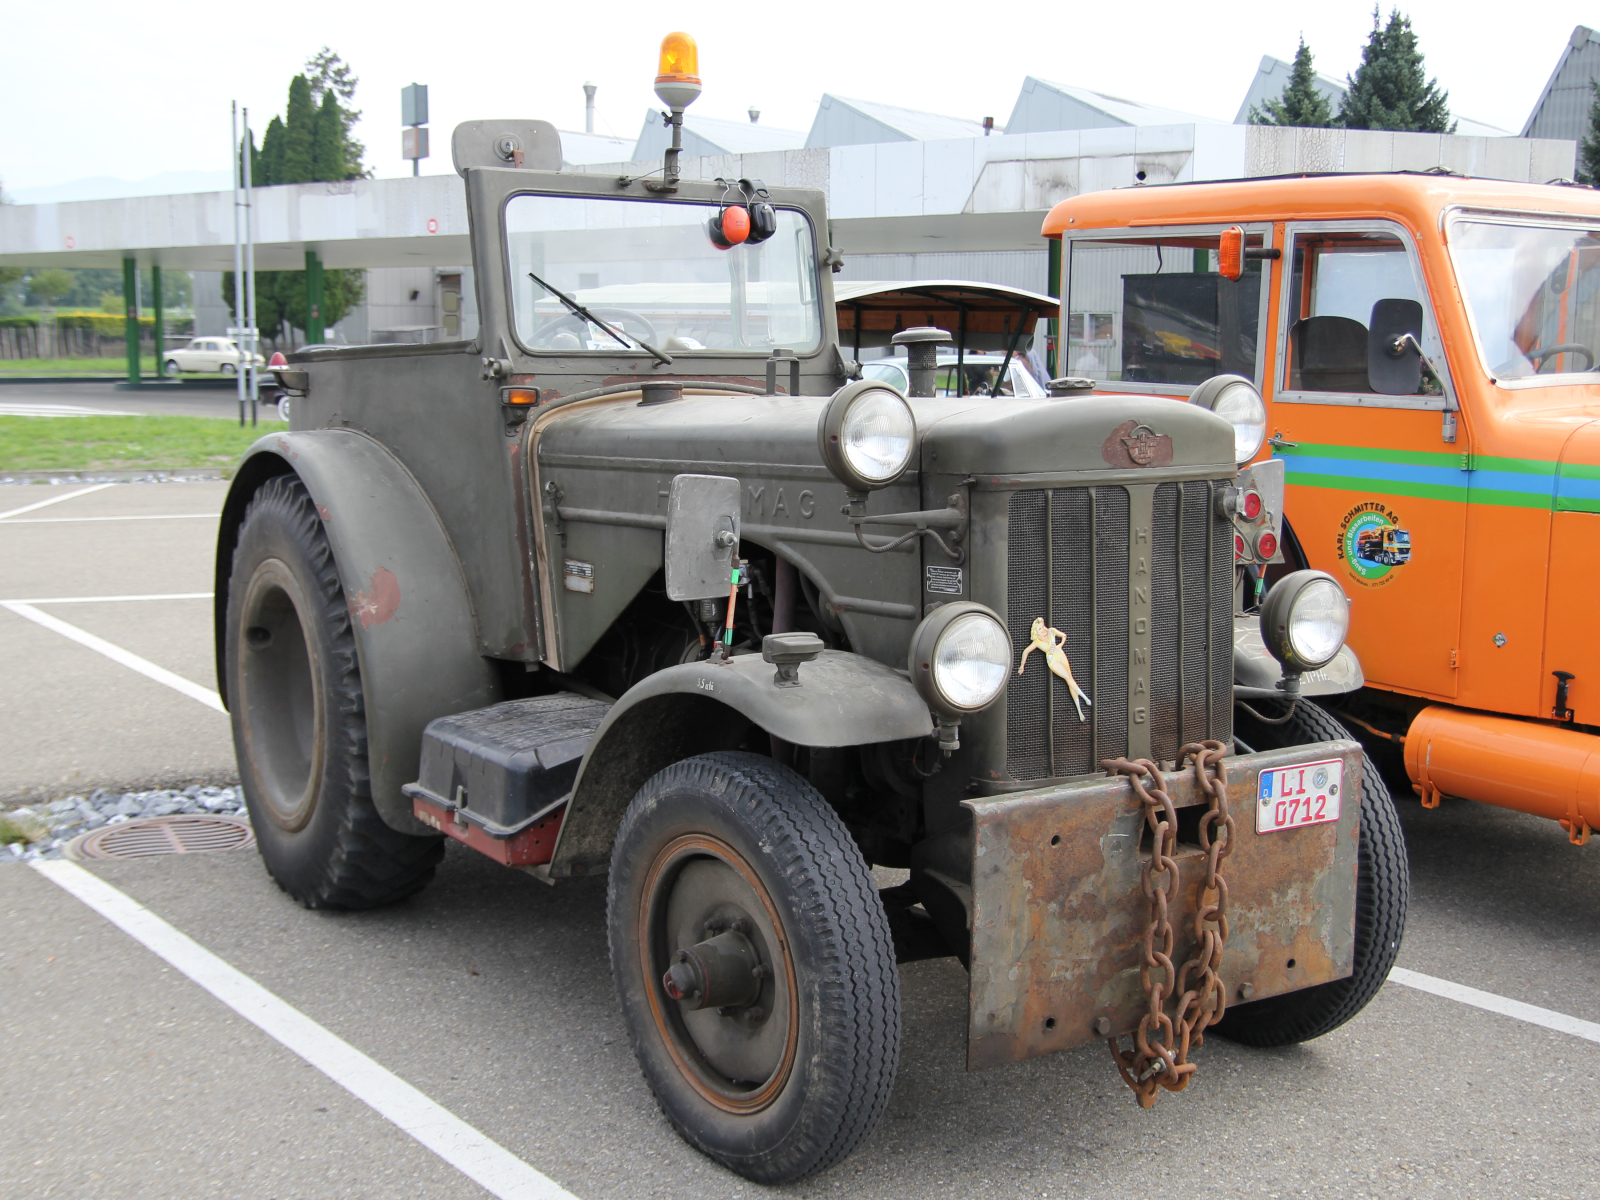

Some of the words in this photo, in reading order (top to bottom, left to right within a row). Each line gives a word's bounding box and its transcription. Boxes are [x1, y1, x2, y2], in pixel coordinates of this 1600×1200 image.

[656, 479, 816, 520] HMAG
[1336, 532, 1344, 560] KARL
[1340, 502, 1386, 530] SCHMITTER
[1386, 510, 1399, 525] AG
[1347, 514, 1384, 539] Blasarbeiten
[1351, 556, 1367, 576] Saug-
[1132, 526, 1148, 725] HANOMAG
[1263, 788, 1268, 797] D
[1281, 769, 1306, 797] LI
[1275, 794, 1327, 827] 0712
